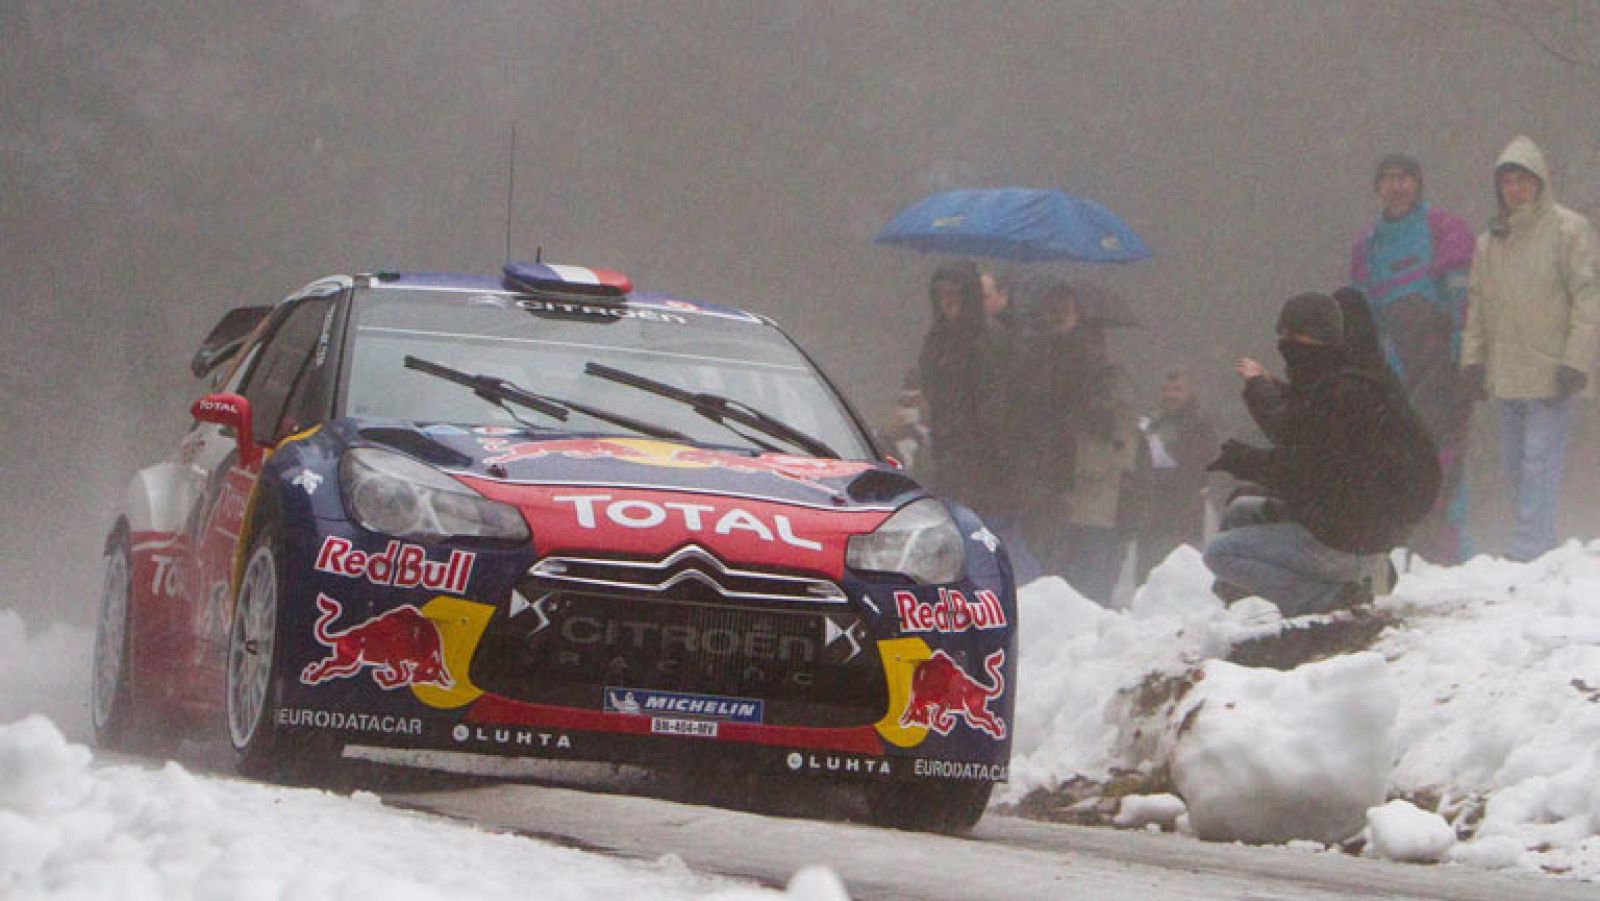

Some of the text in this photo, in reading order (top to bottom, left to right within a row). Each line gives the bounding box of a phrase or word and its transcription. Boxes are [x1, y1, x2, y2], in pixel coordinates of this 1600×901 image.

[551, 494, 823, 551] TOTAL
[315, 536, 476, 594] Red Bull
[894, 588, 1006, 632] Red Bull
[644, 695, 757, 717] MICHELIN
[278, 708, 423, 735] EURODATACAR
[476, 727, 573, 749] LUHTA
[810, 755, 891, 774] LUHTA
